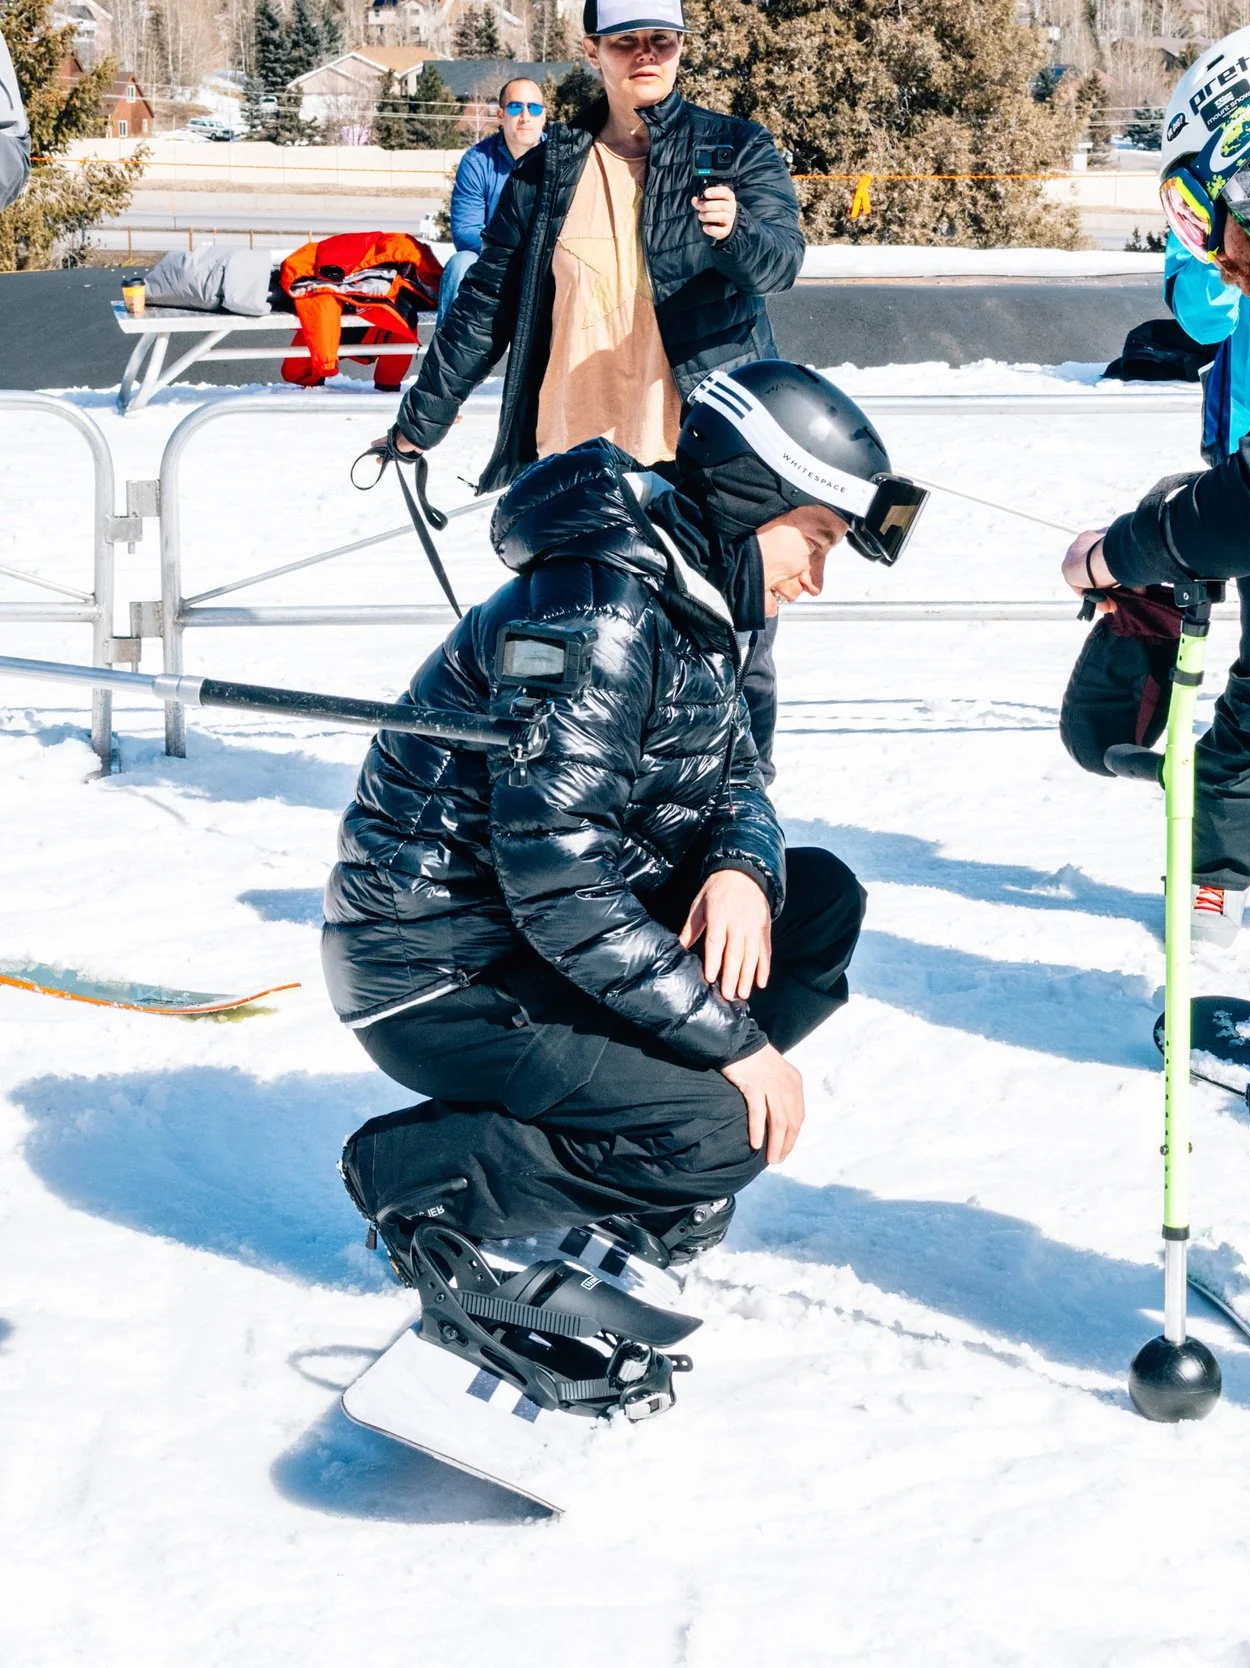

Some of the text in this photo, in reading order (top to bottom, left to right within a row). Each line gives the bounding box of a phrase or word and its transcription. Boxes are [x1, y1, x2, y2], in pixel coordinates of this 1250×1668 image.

[1189, 56, 1250, 116] pret
[1207, 105, 1230, 125] mount
[1230, 91, 1250, 108] snow
[782, 452, 846, 493] WHITESPACE
